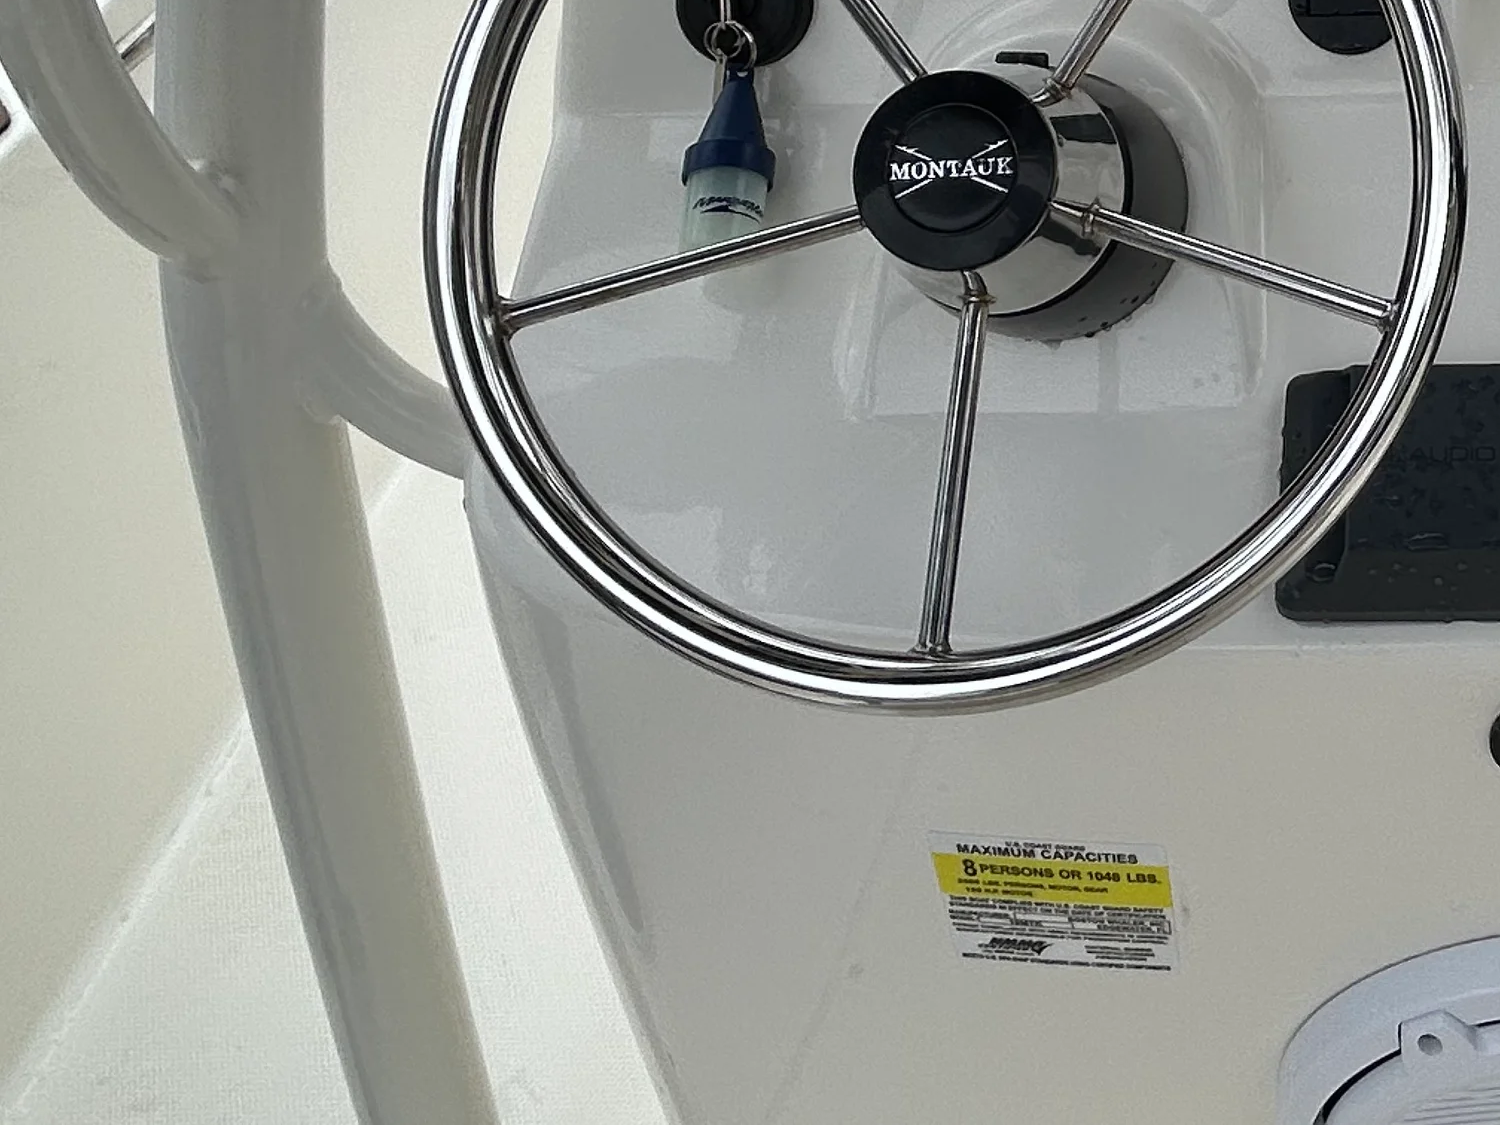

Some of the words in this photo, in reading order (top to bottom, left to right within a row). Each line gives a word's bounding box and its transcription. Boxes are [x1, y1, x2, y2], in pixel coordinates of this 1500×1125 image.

[889, 156, 1014, 181] MONTAUK
[956, 843, 1036, 859] MAXIMUM
[1041, 850, 1138, 865] CAPACITIES
[962, 858, 977, 877] 8
[979, 863, 1055, 879] PERSONS
[1059, 869, 1082, 881] OR
[1126, 872, 1162, 884] LBS.
